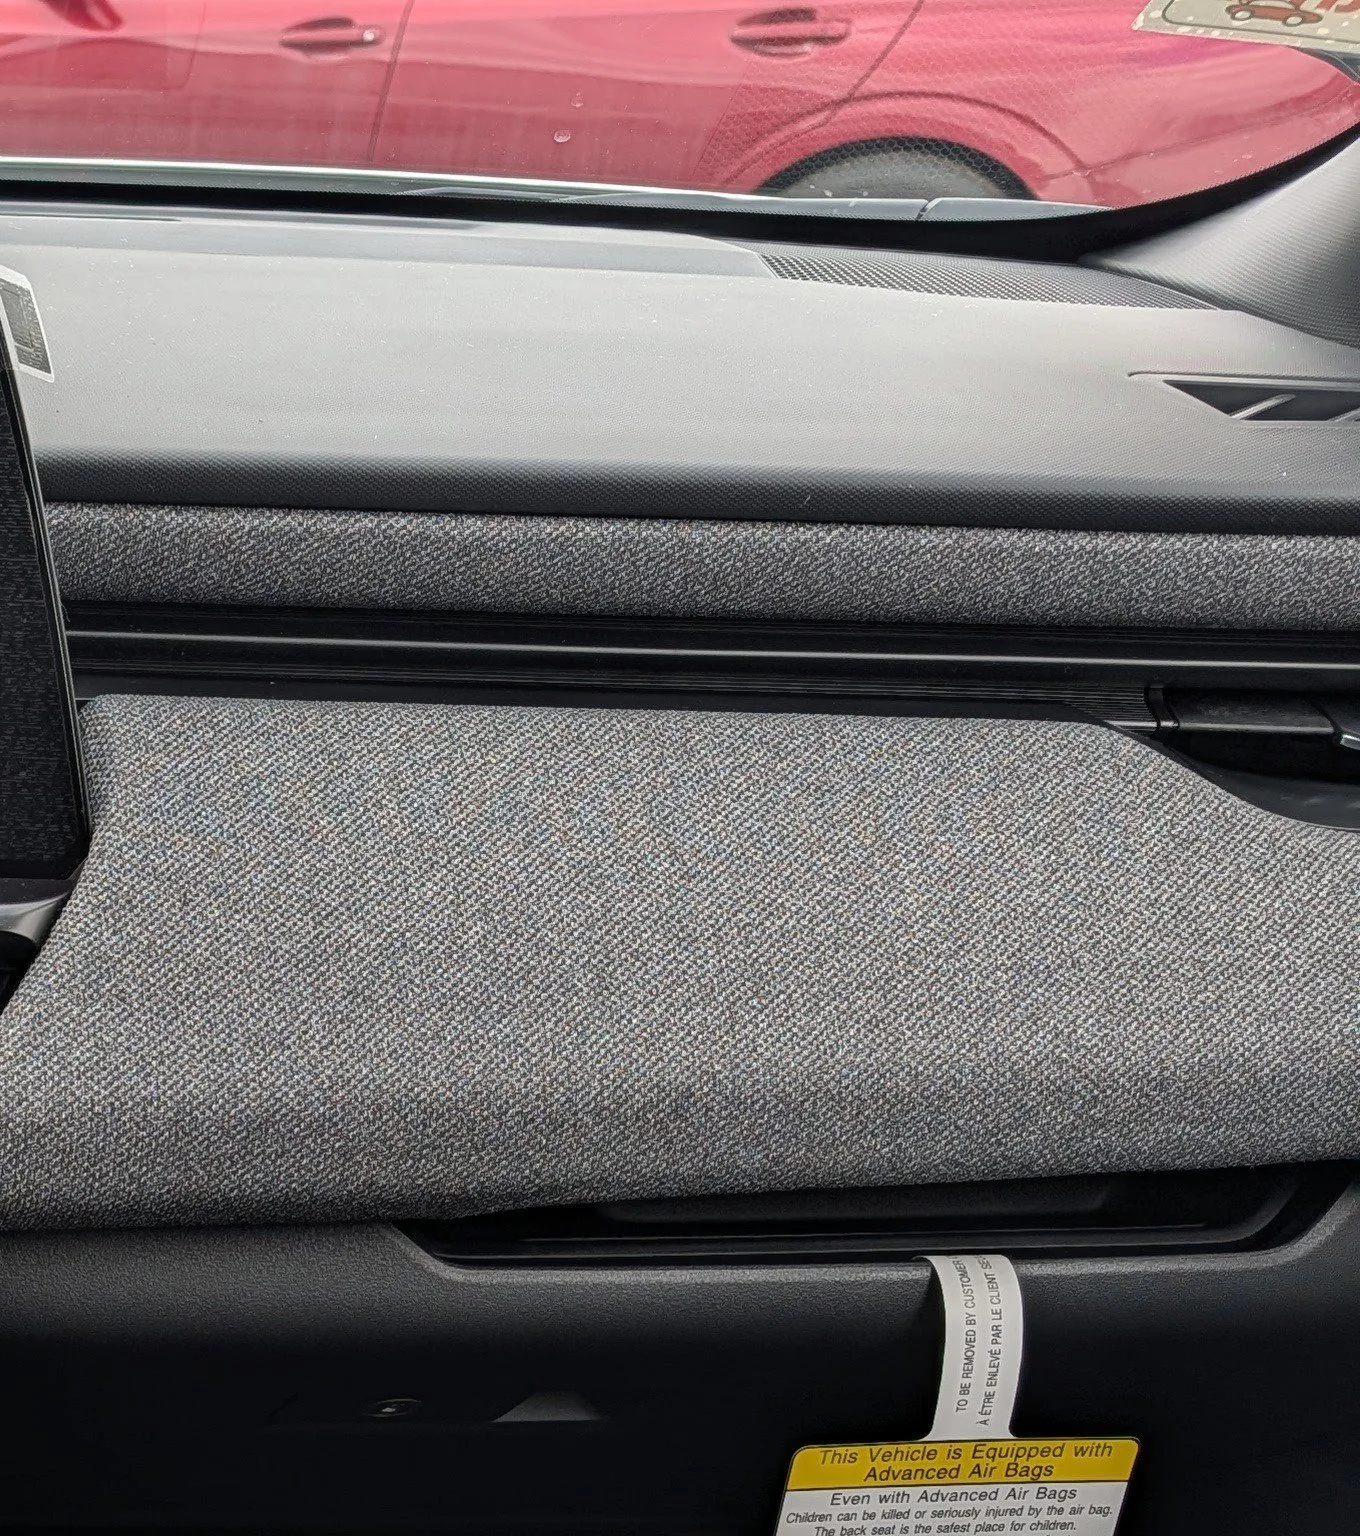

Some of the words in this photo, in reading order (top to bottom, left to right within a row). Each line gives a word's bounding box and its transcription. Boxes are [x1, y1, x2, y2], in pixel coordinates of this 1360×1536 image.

[983, 1273, 1001, 1305] CLIENT
[966, 1313, 976, 1326] BY
[994, 1308, 1002, 1322] LE
[992, 1325, 1002, 1345] PAR
[962, 1330, 976, 1379] REMOVED
[959, 1383, 970, 1395] BE
[956, 1399, 968, 1413] TO
[820, 1450, 858, 1465] This
[869, 1446, 937, 1462] Vehicle
[946, 1444, 962, 1460] is
[972, 1443, 1066, 1462] Equipped
[1074, 1443, 1113, 1457] with
[864, 1464, 961, 1482] Advanced
[969, 1463, 996, 1478] Air
[1005, 1463, 1054, 1480] Bags
[830, 1493, 870, 1506] Even
[879, 1491, 910, 1504] with
[917, 1488, 1000, 1503] Advanced
[1005, 1487, 1029, 1500] Air
[1036, 1486, 1077, 1502] Bags
[786, 1512, 832, 1524] Children
[837, 1512, 857, 1521] can
[862, 1510, 876, 1521] be
[881, 1508, 914, 1520] killed
[915, 1510, 927, 1519] or
[931, 1507, 980, 1520] seriously
[985, 1505, 1024, 1519] injured
[1028, 1506, 1042, 1518] by
[1047, 1505, 1064, 1516] the
[1069, 1505, 1085, 1516] air
[1089, 1504, 1113, 1517] bag.
[814, 1526, 835, 1536] The
[840, 1525, 866, 1536] back
[871, 1525, 896, 1536] seat
[900, 1524, 909, 1535] is
[914, 1523, 931, 1534] the
[936, 1522, 970, 1534] safest
[974, 1522, 1005, 1535] place
[1010, 1521, 1026, 1532] for
[1030, 1520, 1077, 1531] children.
